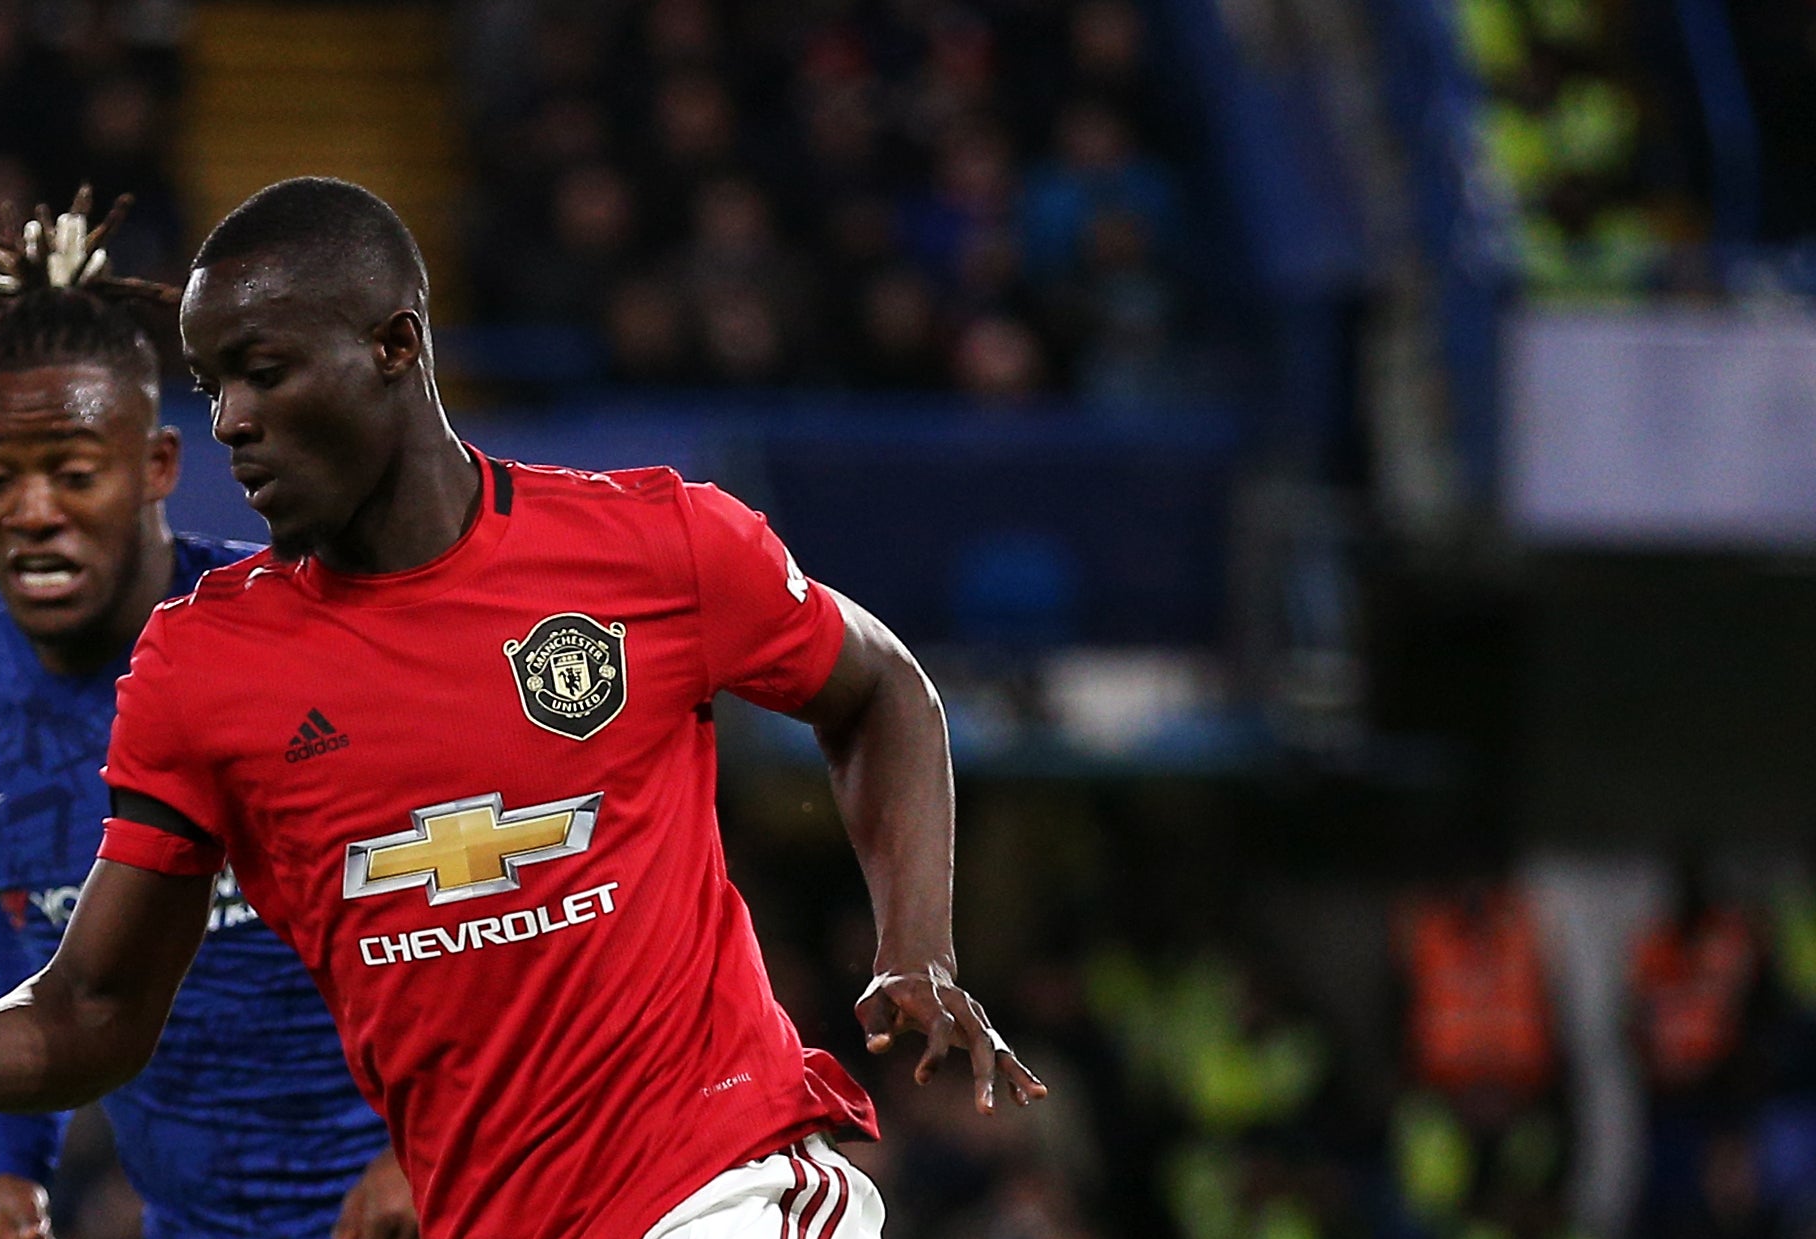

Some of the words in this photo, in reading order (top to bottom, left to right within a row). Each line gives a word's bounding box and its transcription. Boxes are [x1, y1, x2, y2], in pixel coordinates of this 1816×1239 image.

[533, 636, 603, 669] MANCHESTER
[551, 693, 601, 712] UNITED
[285, 734, 350, 763] adidas
[359, 882, 618, 965] CHEVROLET
